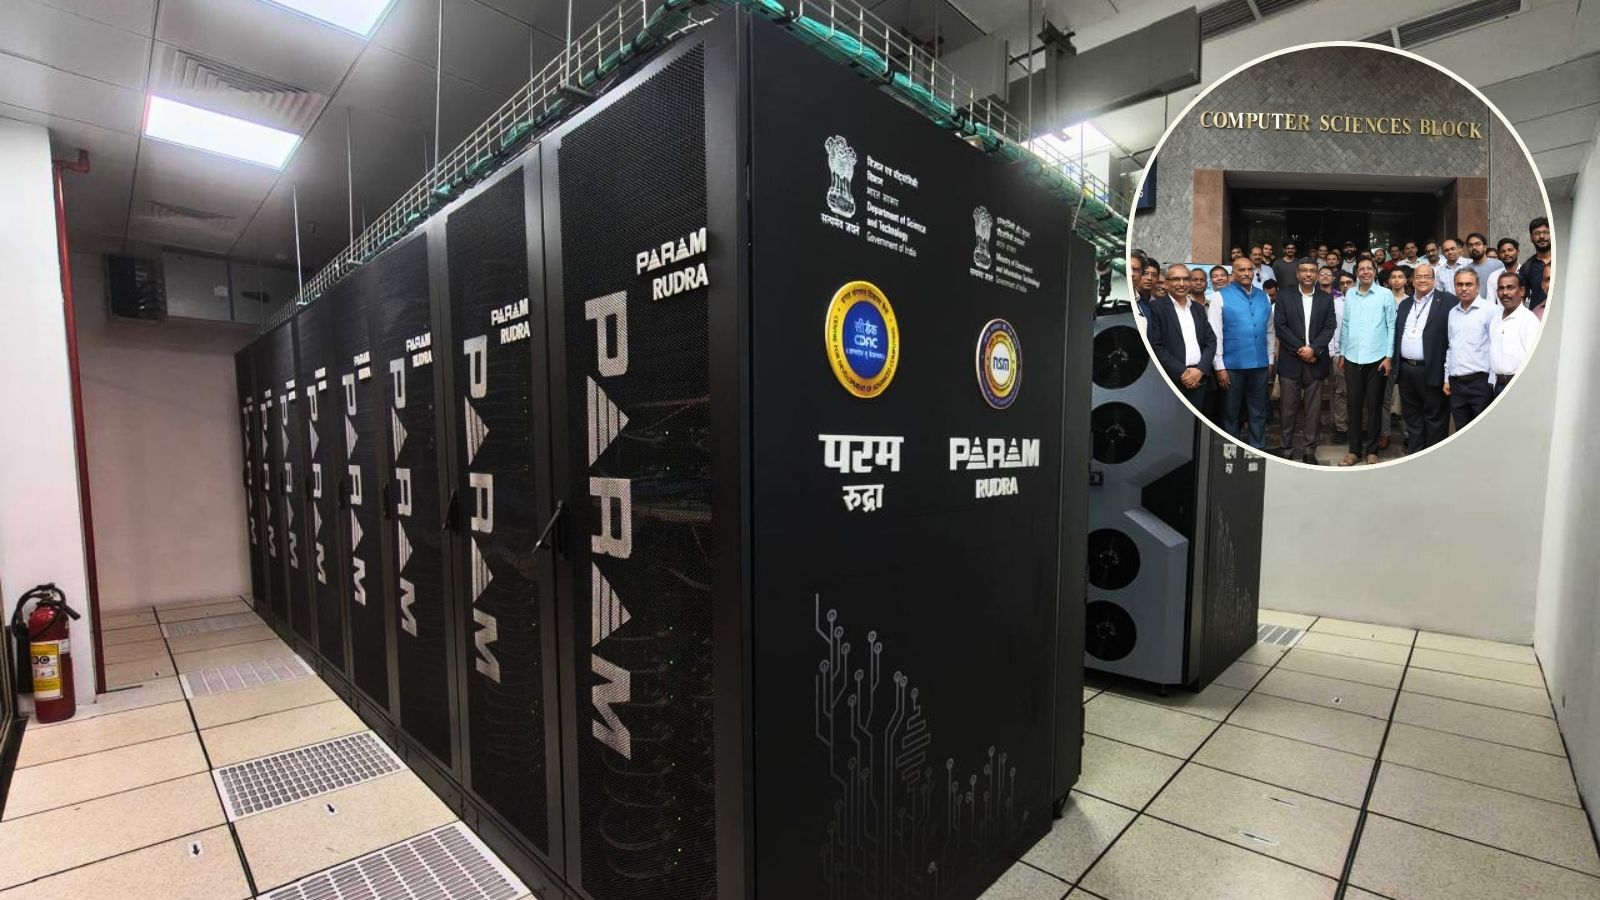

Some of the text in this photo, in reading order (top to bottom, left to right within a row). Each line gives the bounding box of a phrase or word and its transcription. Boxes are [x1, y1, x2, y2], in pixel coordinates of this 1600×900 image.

[1200, 110, 1483, 139] COMPUTER SCIENCES BLOCK
[636, 227, 706, 275] PARAM
[653, 262, 709, 301] RUDRA
[491, 298, 529, 326] PARAM
[500, 321, 530, 345] RUDRA
[818, 433, 904, 473] परम
[950, 436, 1040, 470] PARAM
[307, 385, 327, 585] PARAM
[342, 373, 366, 606] PARAM
[389, 357, 418, 638] PARAM
[975, 476, 1019, 499] RUDRA
[464, 334, 501, 683] PARAM
[585, 290, 632, 760] PARAM
